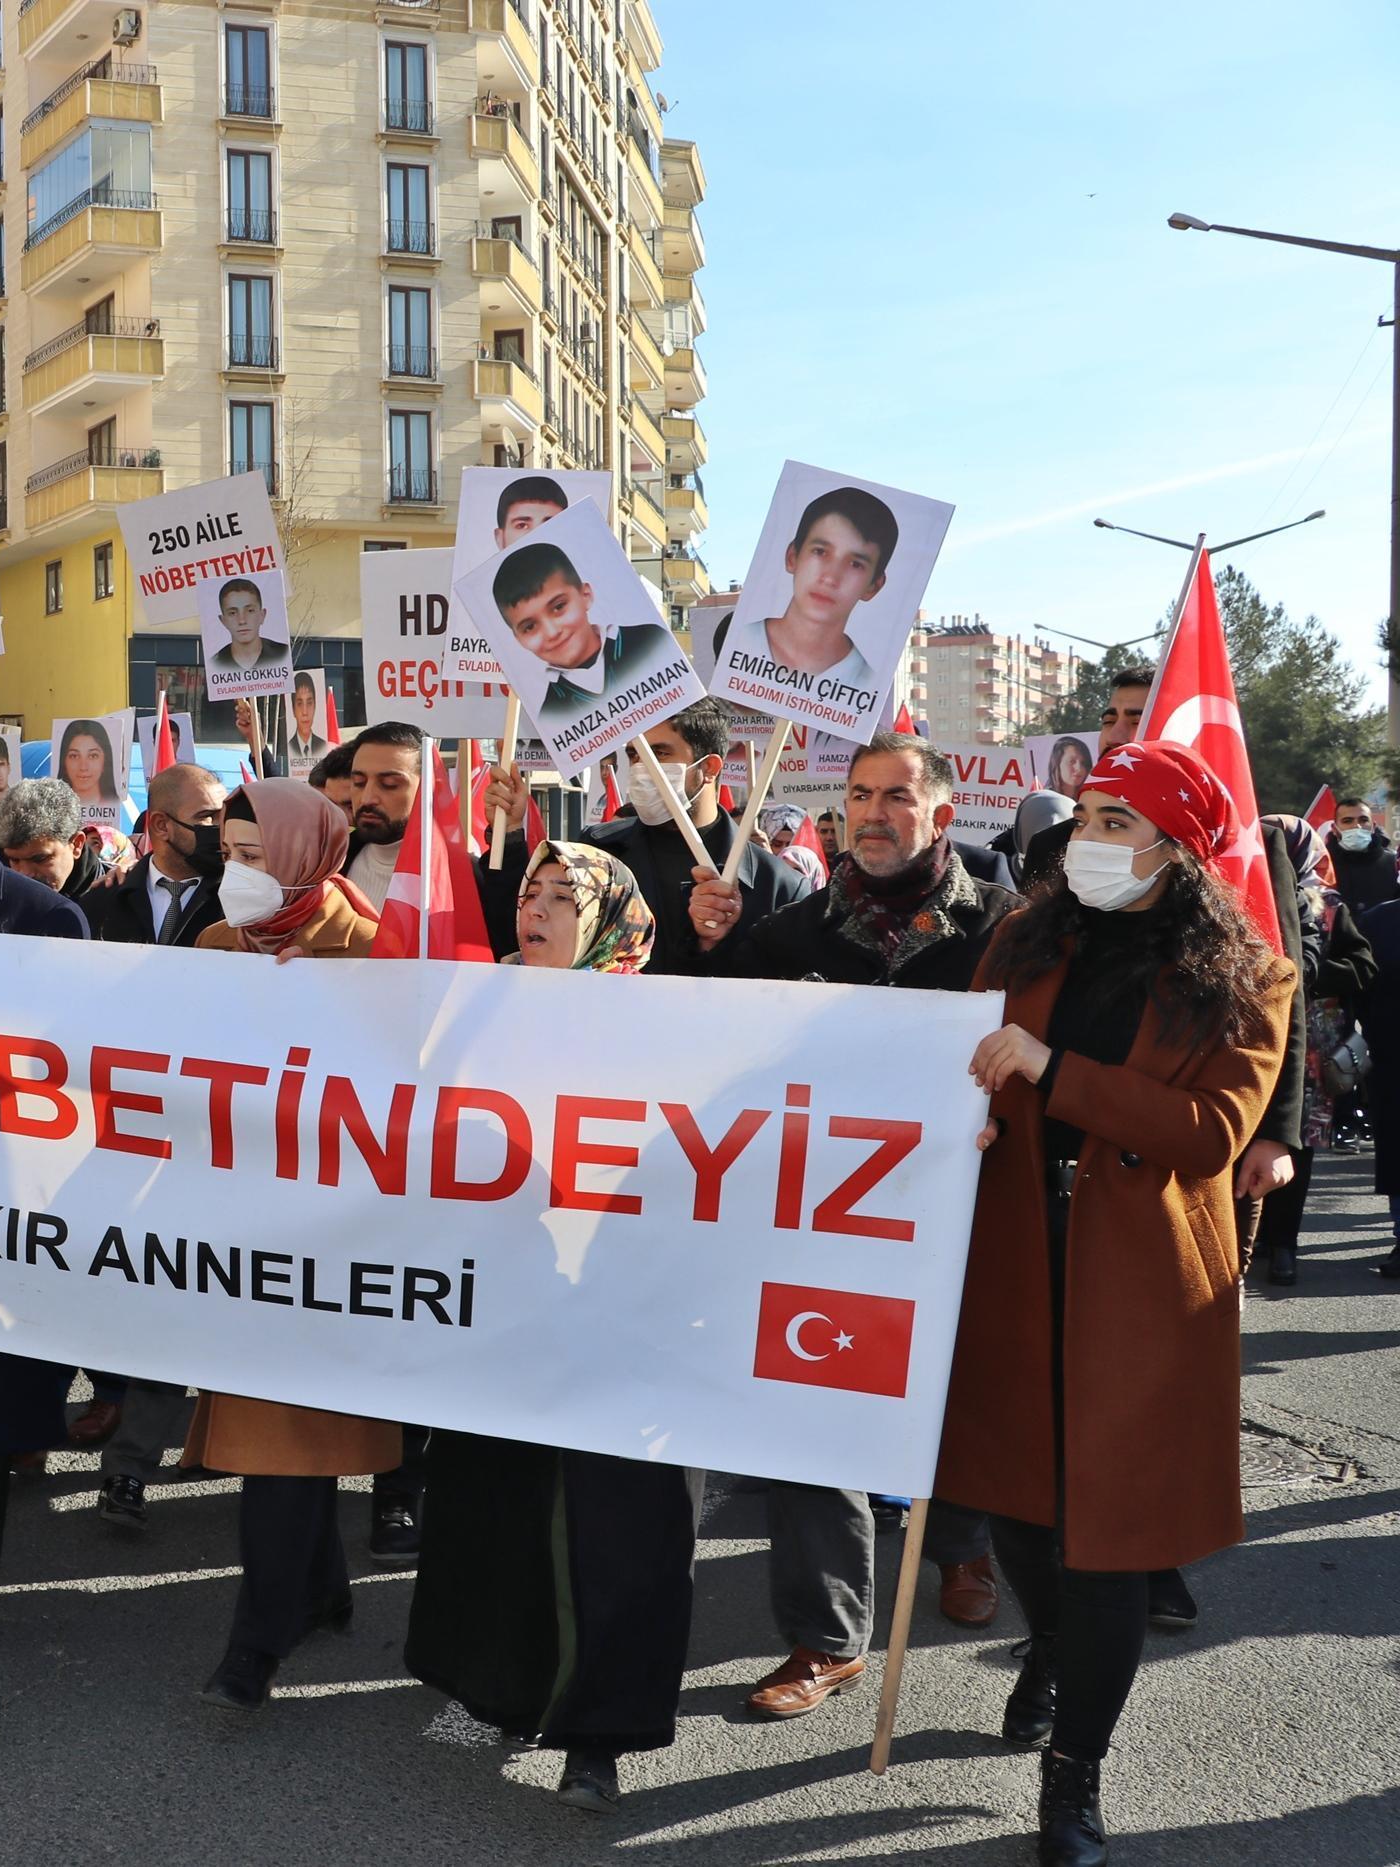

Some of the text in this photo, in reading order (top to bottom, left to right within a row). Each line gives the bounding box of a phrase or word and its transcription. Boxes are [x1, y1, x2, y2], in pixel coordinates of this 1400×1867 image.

[148, 512, 243, 555] 250 AİLE
[139, 545, 277, 597] NÖBETTEYİZ!
[399, 594, 450, 636] HD
[450, 637, 492, 654] BAYR
[211, 667, 289, 685] OKAN GÖKKUŞ
[217, 682, 285, 695] EVLADIMI İSTİYORUM!
[728, 650, 879, 715] EMİRCAN ÇİFTÇİ
[552, 658, 690, 752] HAMZA ADIYAMAN
[728, 676, 858, 728] EVLADIMI İSTİYORUM!
[569, 685, 686, 763] EVLADIMI İSTİYORUM!
[778, 757, 808, 772] NÖB
[818, 754, 850, 763] HAMZA
[942, 752, 1024, 788] VLA
[782, 783, 832, 794] DİYARBAKIR
[88, 804, 116, 818] ÖNEN
[950, 818, 987, 830] RBAKIR
[88, 1226, 476, 1328] ANNELERİ
